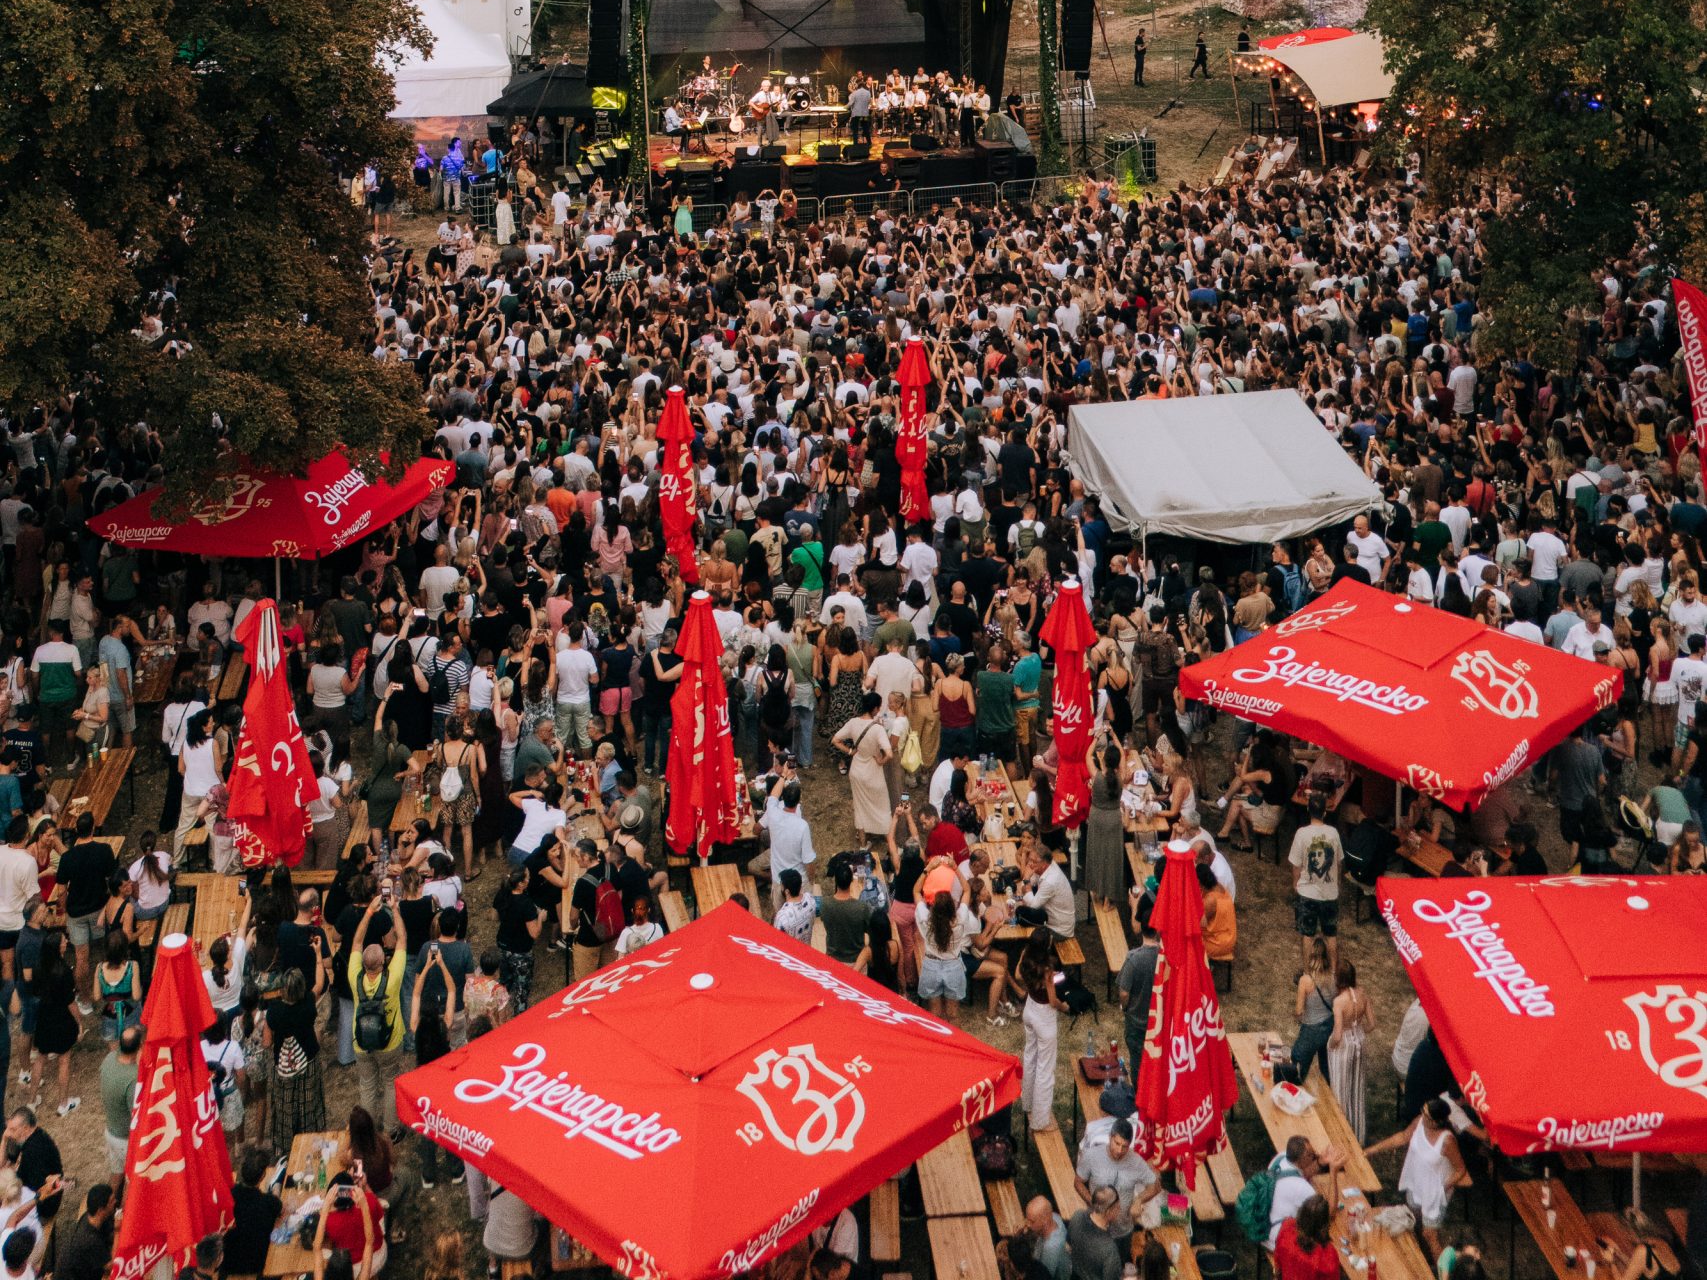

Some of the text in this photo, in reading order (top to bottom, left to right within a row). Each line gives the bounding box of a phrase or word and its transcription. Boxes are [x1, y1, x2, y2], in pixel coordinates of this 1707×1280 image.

[255, 498, 272, 508] 95
[102, 523, 172, 543] Зајечарско
[1512, 658, 1531, 675] 95
[1232, 645, 1429, 715] Зајечарско
[1198, 679, 1284, 717] Зајечарско
[1461, 695, 1479, 712] 18
[1413, 890, 1555, 1017] Зајечарско
[1604, 1030, 1632, 1051] 18
[843, 1055, 873, 1079] 95
[454, 1043, 682, 1160] Зајечарско
[411, 1096, 495, 1157] Зајечарско
[735, 1122, 764, 1147] 18
[1526, 1111, 1664, 1152] Зајечарско
